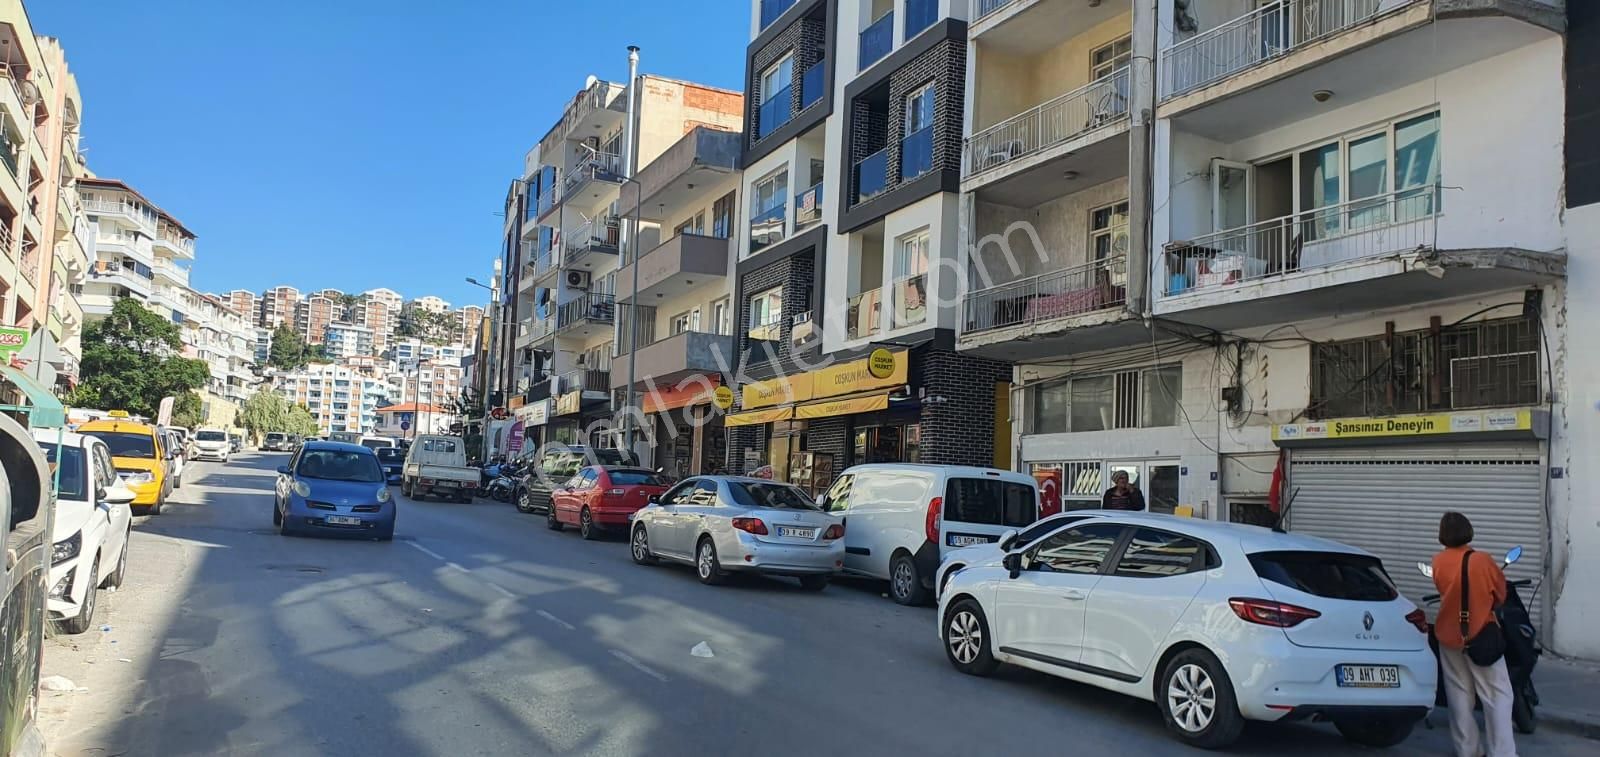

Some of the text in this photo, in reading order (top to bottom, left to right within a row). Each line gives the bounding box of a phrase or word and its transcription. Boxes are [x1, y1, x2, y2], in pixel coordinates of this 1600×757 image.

[1335, 422, 1384, 436] Şansınızı
[1387, 418, 1434, 433] Deneyin
[1343, 667, 1397, 682] 09 AHT 039
